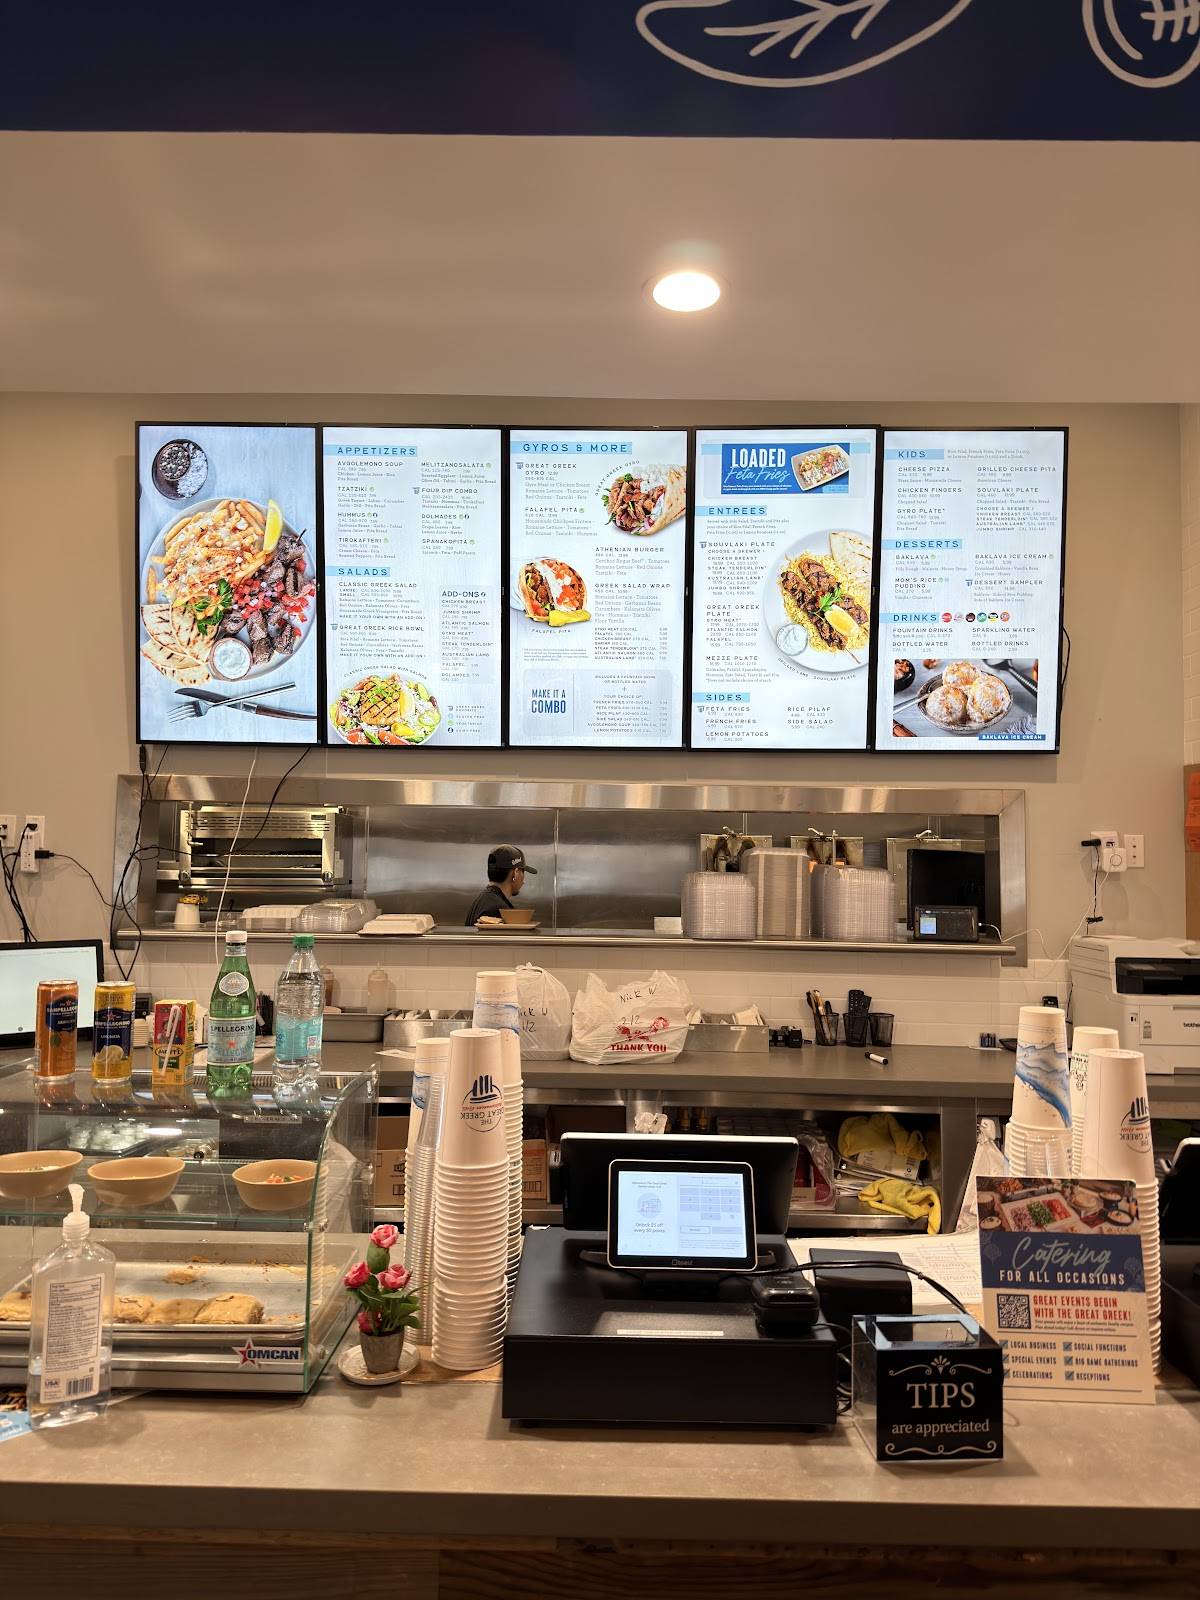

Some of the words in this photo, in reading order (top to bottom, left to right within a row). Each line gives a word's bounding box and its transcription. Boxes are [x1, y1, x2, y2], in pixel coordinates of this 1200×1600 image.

[337, 447, 416, 455] APPETIZERS
[523, 443, 569, 452] GYROS
[576, 444, 583, 452] &
[590, 444, 628, 452] MORE
[731, 448, 786, 468] LOADED
[724, 465, 756, 483] Feta
[754, 465, 791, 483] Fries
[708, 507, 766, 515] ENTREES
[338, 568, 388, 576] SALADS
[441, 590, 480, 598] ADD-ONS
[893, 614, 937, 622] DRINKS
[531, 689, 551, 698] MAKE
[553, 689, 559, 698] IT
[561, 689, 566, 698] A
[531, 700, 566, 714] COMBO
[610, 1044, 644, 1052] THANK
[646, 1043, 667, 1053] YOU
[460, 1111, 485, 1120] GREEK
[1012, 1236, 1111, 1276] Catering
[999, 1270, 1022, 1282] FOR
[1029, 1271, 1050, 1283] ALL
[1056, 1271, 1126, 1285] OCCASIONS
[1033, 1295, 1057, 1306] GREAT
[1061, 1296, 1090, 1307] EVENTS
[1093, 1297, 1118, 1308] BEGIN
[1033, 1307, 1054, 1319] WITH
[1057, 1308, 1072, 1319] THE
[1074, 1309, 1101, 1320] GREAT
[1102, 1310, 1132, 1321] GREEK!
[1010, 1340, 1027, 1349] LOCAL
[1029, 1341, 1057, 1350] BUSINESS
[1074, 1342, 1093, 1351] SOCIAL
[1096, 1343, 1127, 1353] FUNCTIONS
[247, 1349, 299, 1360] OMCAN
[1011, 1355, 1035, 1365] SPECIAL
[1036, 1356, 1057, 1365] EVENTS
[1075, 1357, 1085, 1366] BIG
[1086, 1357, 1102, 1366] GAME
[1104, 1358, 1138, 1368] GATHERINGS
[1012, 1370, 1052, 1380] CELEBRATIONS
[1076, 1373, 1110, 1382] RECEPTIONS
[906, 1382, 976, 1409] TIPS
[891, 1423, 913, 1434] are
[915, 1419, 990, 1437] appreciated
